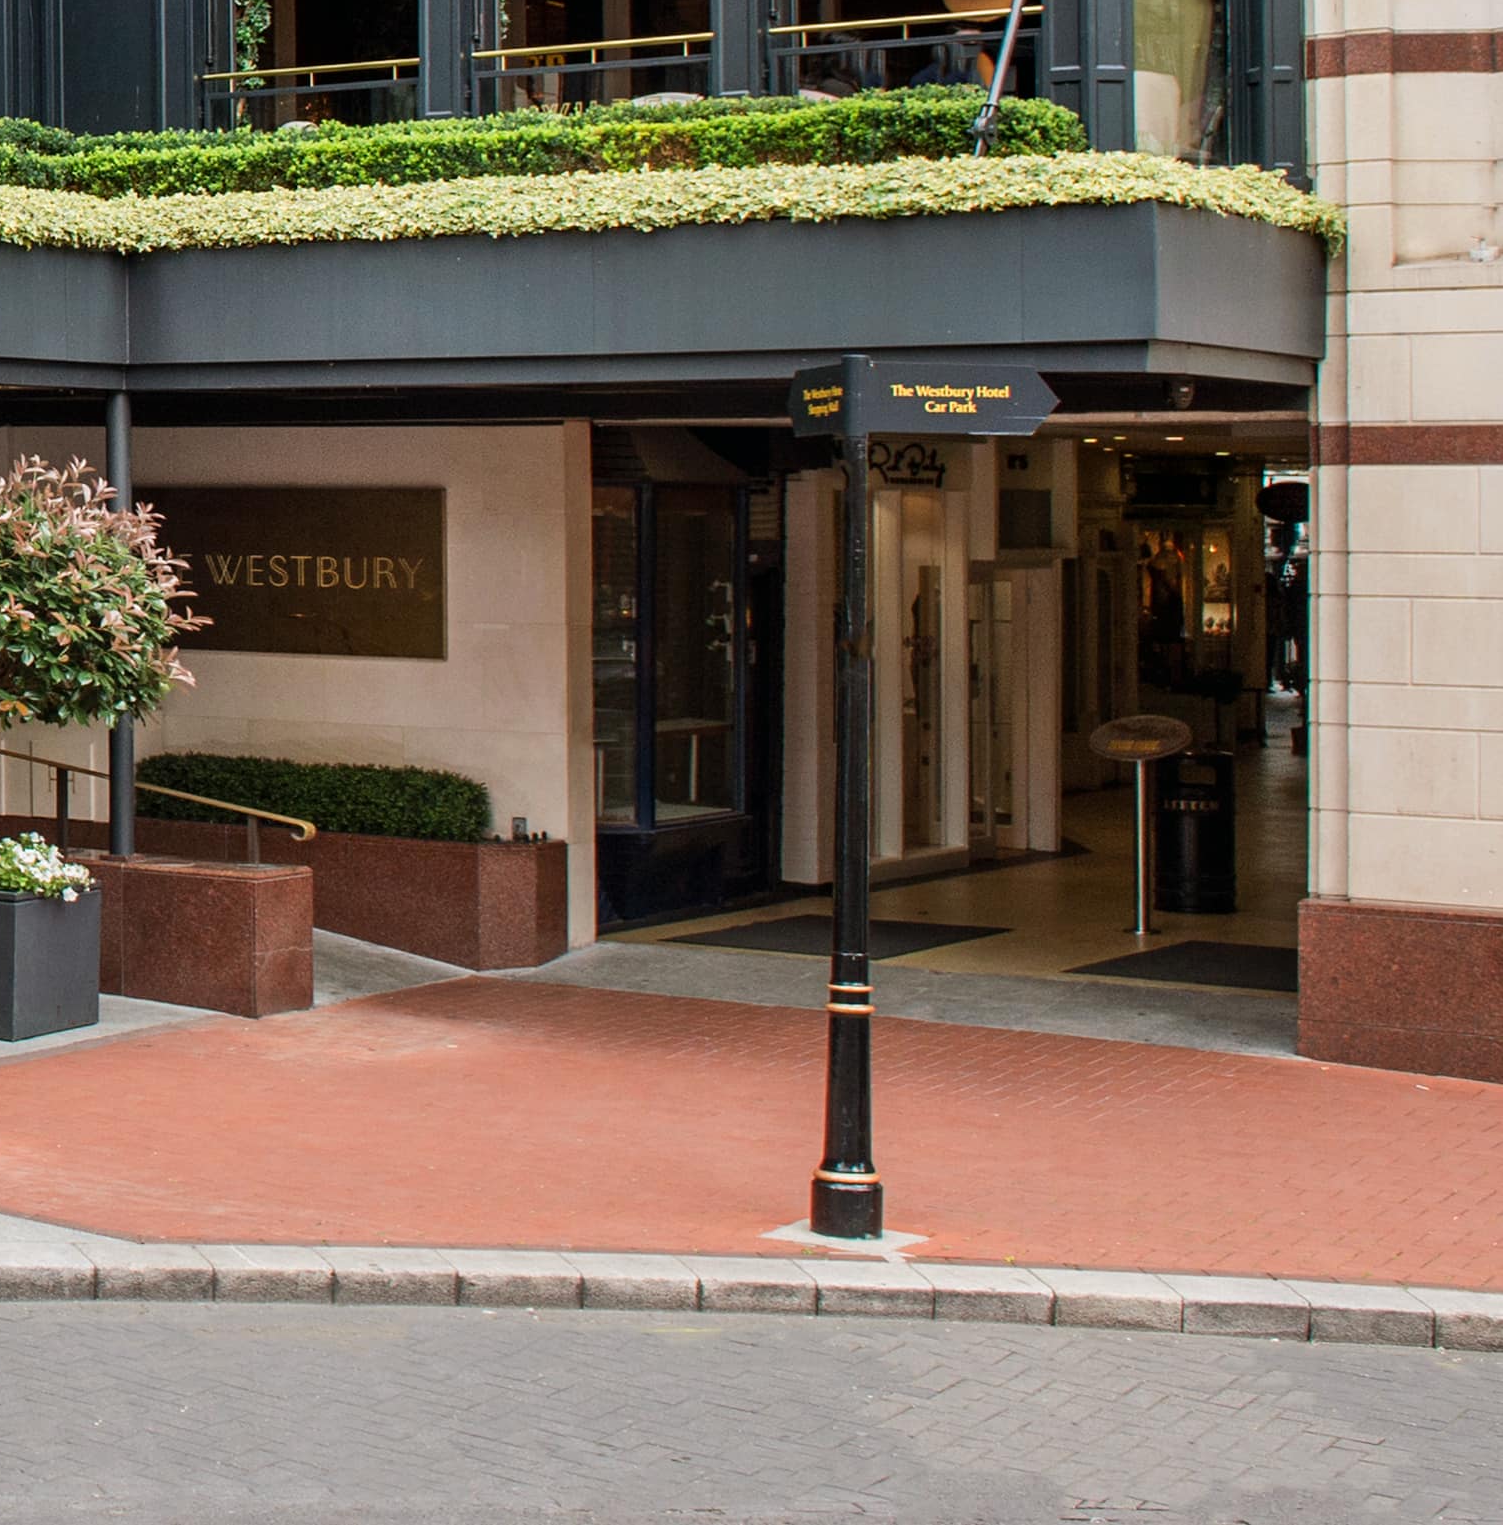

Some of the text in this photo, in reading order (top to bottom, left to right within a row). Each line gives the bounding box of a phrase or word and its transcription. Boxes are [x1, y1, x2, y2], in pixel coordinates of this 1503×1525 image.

[889, 383, 1011, 401] The Westbury Hotel
[924, 400, 978, 414] Car Park
[204, 553, 425, 590] WESTBURY
